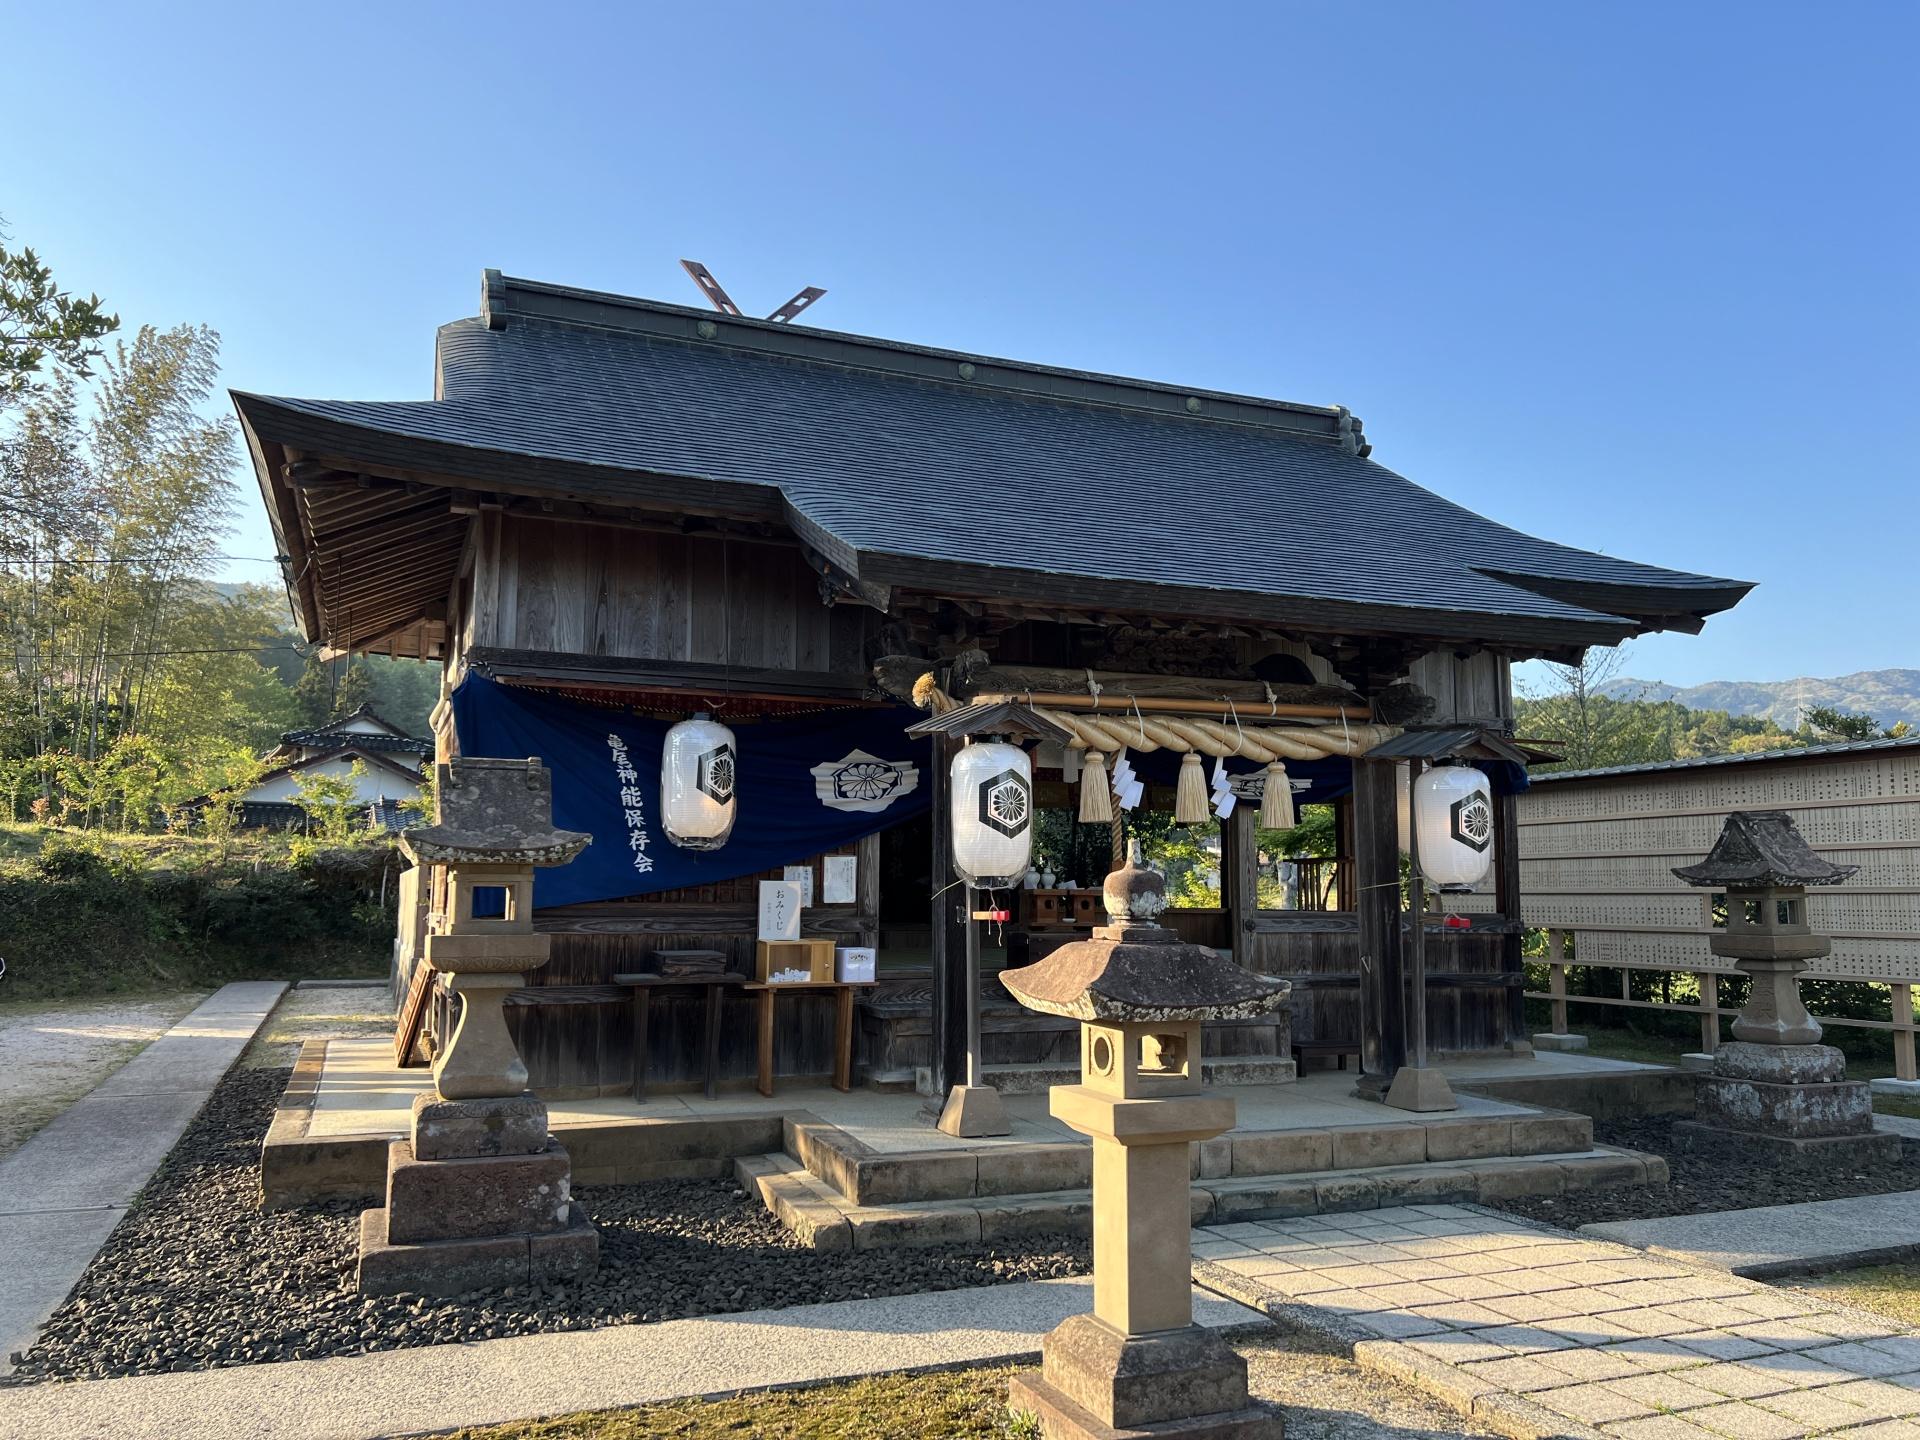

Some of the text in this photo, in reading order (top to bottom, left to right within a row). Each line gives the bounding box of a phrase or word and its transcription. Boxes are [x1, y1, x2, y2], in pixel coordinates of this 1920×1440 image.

[607, 733, 654, 873] 亀尾神能保存会
[775, 889, 785, 931] おみくじ
